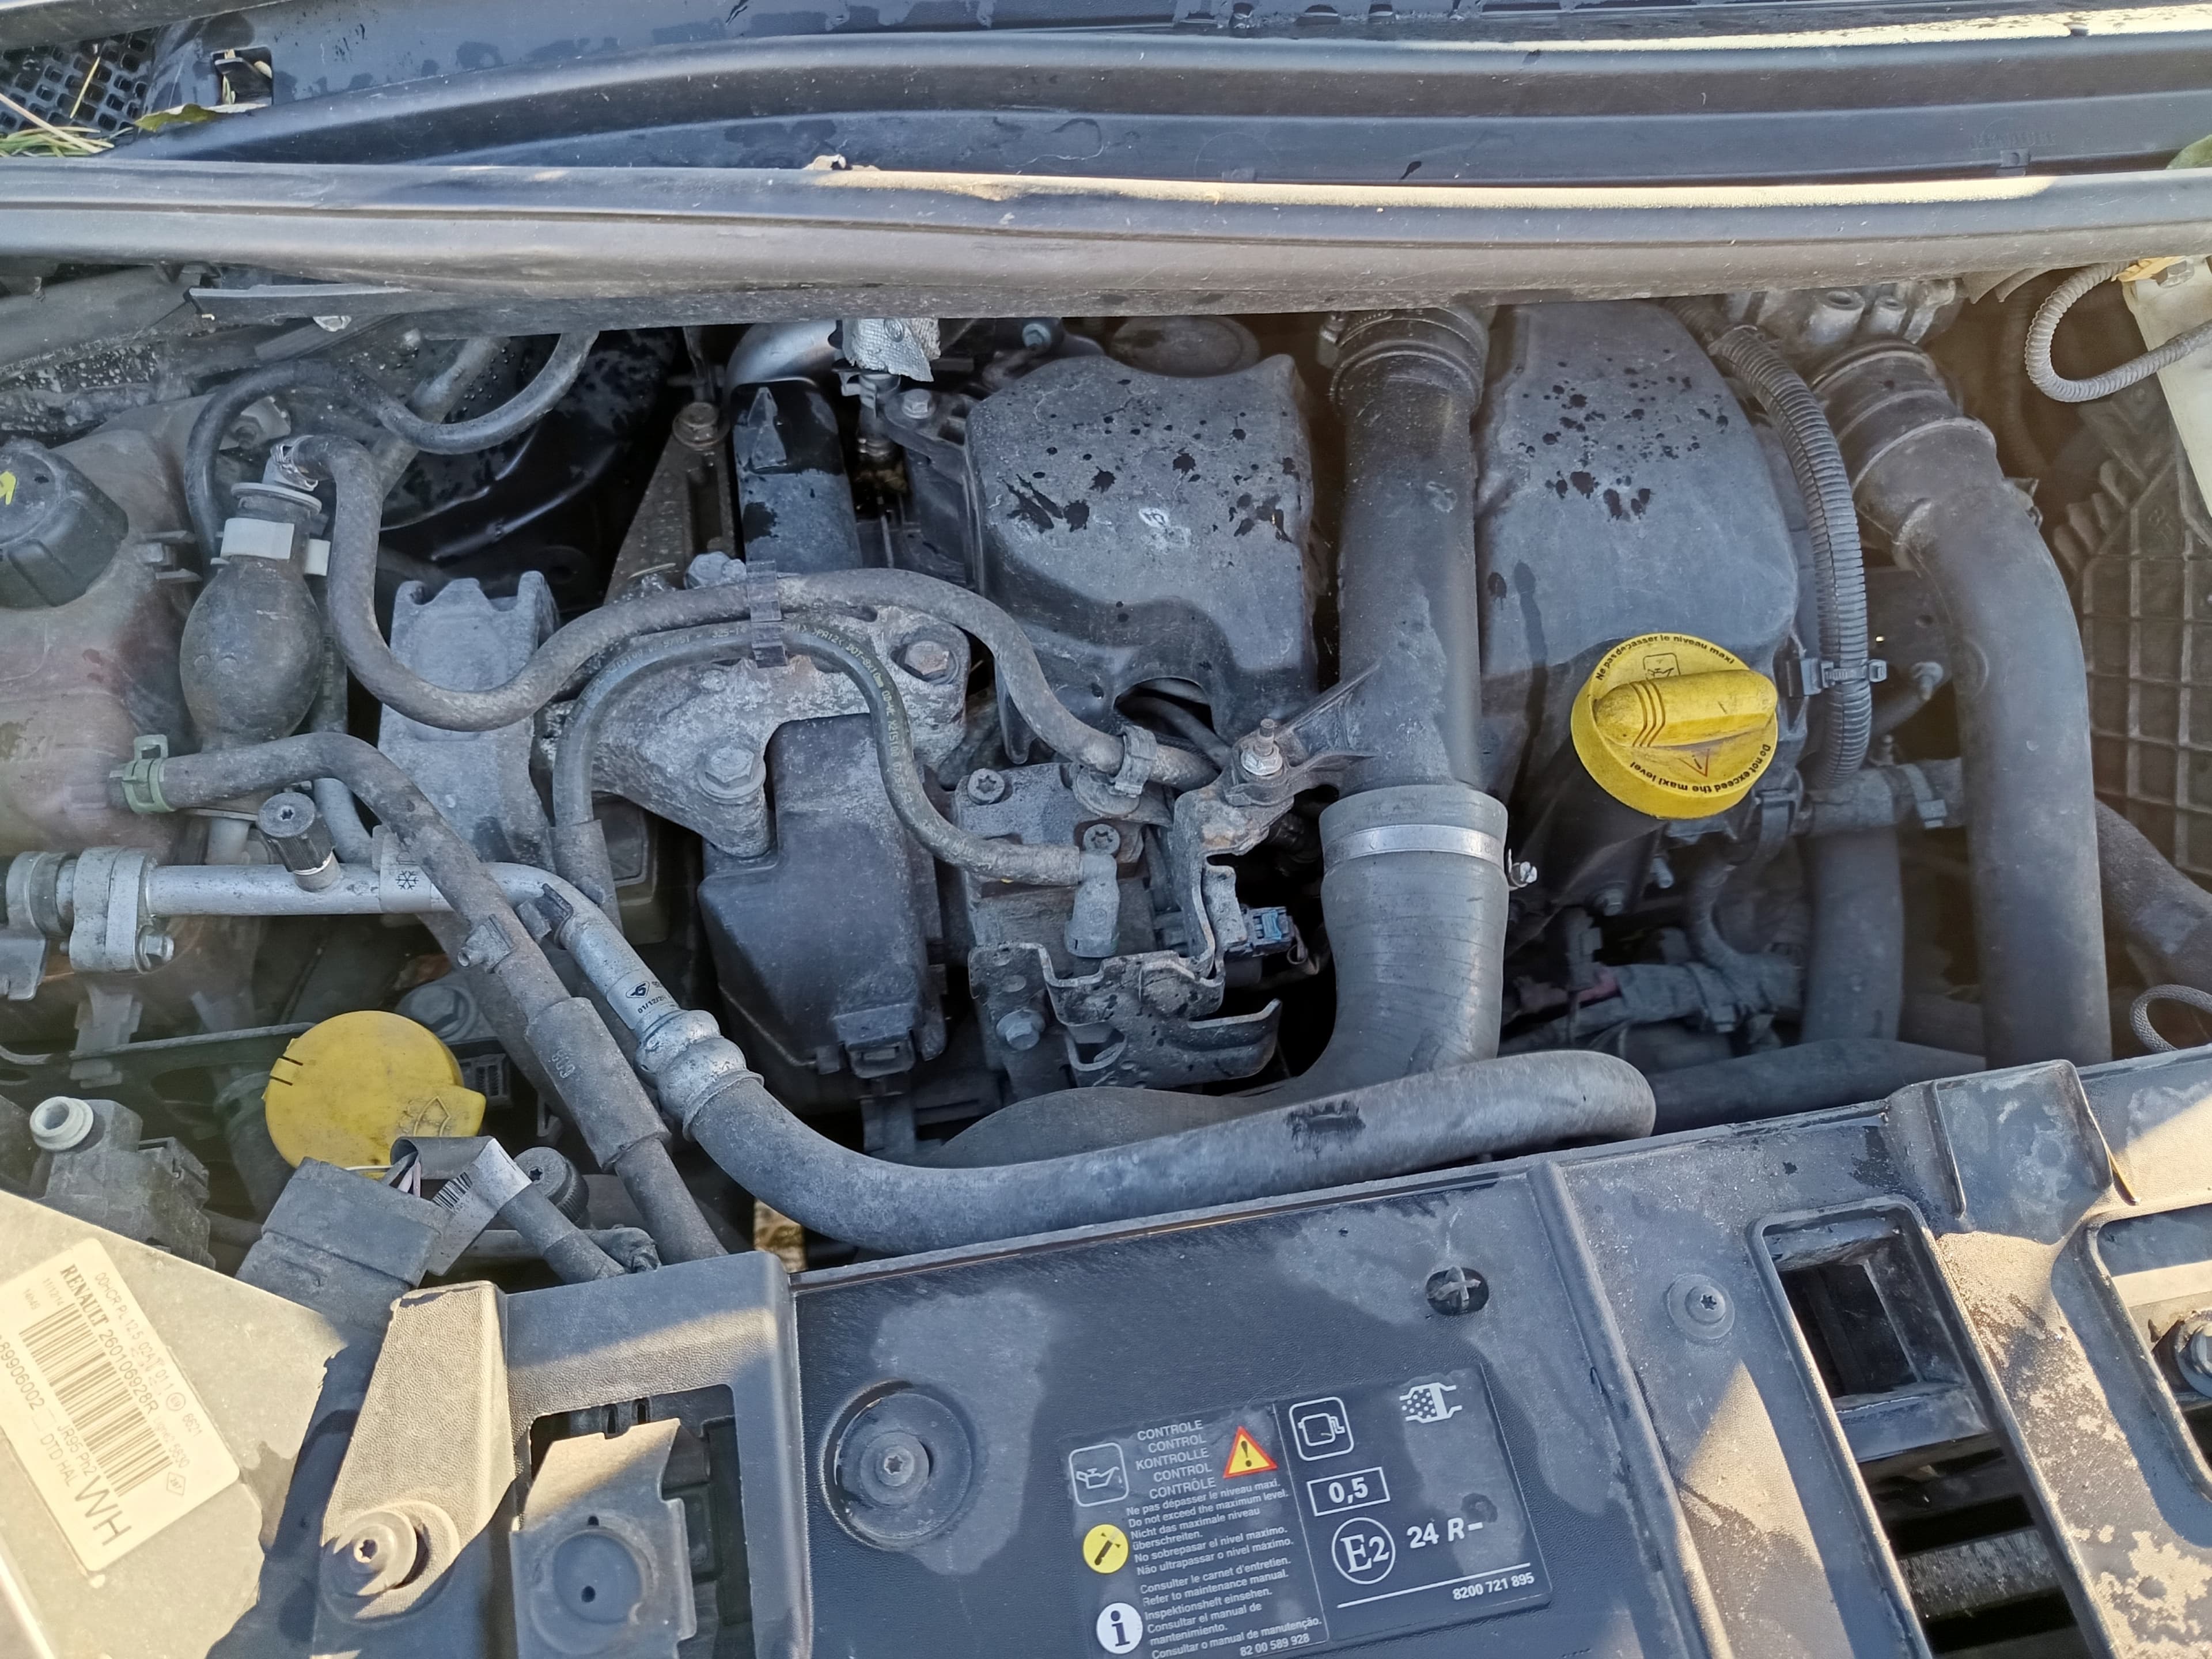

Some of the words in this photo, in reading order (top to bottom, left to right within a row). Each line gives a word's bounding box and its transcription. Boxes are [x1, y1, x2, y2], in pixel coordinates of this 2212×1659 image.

[1596, 668, 1606, 680] Ne
[1604, 654, 1617, 669] pas
[1673, 636, 1707, 650] niveau
[1709, 647, 1735, 664] maxi
[1762, 744, 1771, 757] Do
[1630, 762, 1657, 782] level
[1749, 758, 1763, 774] not
[1658, 778, 1688, 791] maxi
[1692, 785, 1712, 793] the
[1715, 772, 1750, 793] exceed
[60, 1264, 109, 1327] RENAULT
[99, 1329, 160, 1415] 260106928R
[0, 1335, 45, 1411] 89906002
[1137, 1420, 1204, 1441] CONTROLE
[1148, 1434, 1207, 1453] CONTROL
[40, 1433, 64, 1460] DTD
[57, 1461, 77, 1487] HAL
[57, 1425, 84, 1453] JR95
[76, 1452, 97, 1477] Ph2
[1135, 1448, 1209, 1470] KONTROLLE
[1154, 1463, 1212, 1482] CONTROL
[1126, 1507, 1139, 1516] Ne
[1142, 1504, 1160, 1515] pas
[1162, 1494, 1206, 1509] dépasser
[1209, 1491, 1218, 1499] le
[1220, 1486, 1252, 1497] niveau
[1253, 1478, 1280, 1490] maxi.
[1149, 1477, 1217, 1499] CONTRÔLE
[1328, 1477, 1369, 1504] 0,5
[74, 1475, 132, 1546] WH
[1128, 1519, 1142, 1528] Do
[1145, 1514, 1161, 1524] not
[1162, 1506, 1196, 1521] exceed
[1198, 1505, 1213, 1513] the
[1216, 1495, 1262, 1510] maximum
[1263, 1489, 1288, 1501] level.
[1130, 1528, 1157, 1539] Nicht
[1159, 1525, 1177, 1533] das
[1179, 1514, 1225, 1529] maximale
[1228, 1508, 1261, 1520] niveau
[1407, 1522, 1440, 1549] 24
[1132, 1532, 1203, 1550] überschreiten.
[1134, 1554, 1149, 1562] No
[1151, 1543, 1206, 1559] sobrepasar
[1209, 1538, 1218, 1547] el
[1220, 1533, 1243, 1545] nivel
[1340, 1534, 1390, 1574] E2
[1137, 1565, 1157, 1575] Não
[1160, 1554, 1214, 1571] ultrapassar
[1141, 1578, 1188, 1593] Consulter
[1191, 1575, 1200, 1583] le
[1203, 1567, 1234, 1581] carnet
[1236, 1558, 1291, 1574] d'entretien.
[1143, 1595, 1169, 1607] Refer
[1172, 1592, 1181, 1600] to
[1184, 1579, 1247, 1597] maintenance
[1249, 1569, 1289, 1584] manual.
[1453, 1583, 1483, 1601] 8200
[1486, 1578, 1509, 1593] 721
[1510, 1571, 1535, 1588] 895
[1144, 1597, 1222, 1620] Inspektionsheft
[1224, 1589, 1272, 1604] einsehen.
[1147, 1618, 1196, 1633] Consultar
[1199, 1613, 1208, 1622] el
[1210, 1605, 1247, 1620] manual
[1249, 1603, 1262, 1612] de
[1150, 1624, 1228, 1645] mantenimiento.
[1152, 1643, 1198, 1659] Consultar
[1210, 1632, 1244, 1647] manual
[1247, 1630, 1259, 1639] de
[1261, 1617, 1321, 1636] manutenção.
[1240, 1646, 1253, 1656] 82
[1255, 1642, 1268, 1653] 00
[1270, 1638, 1289, 1650] 589
[1291, 1633, 1310, 1645] 928
